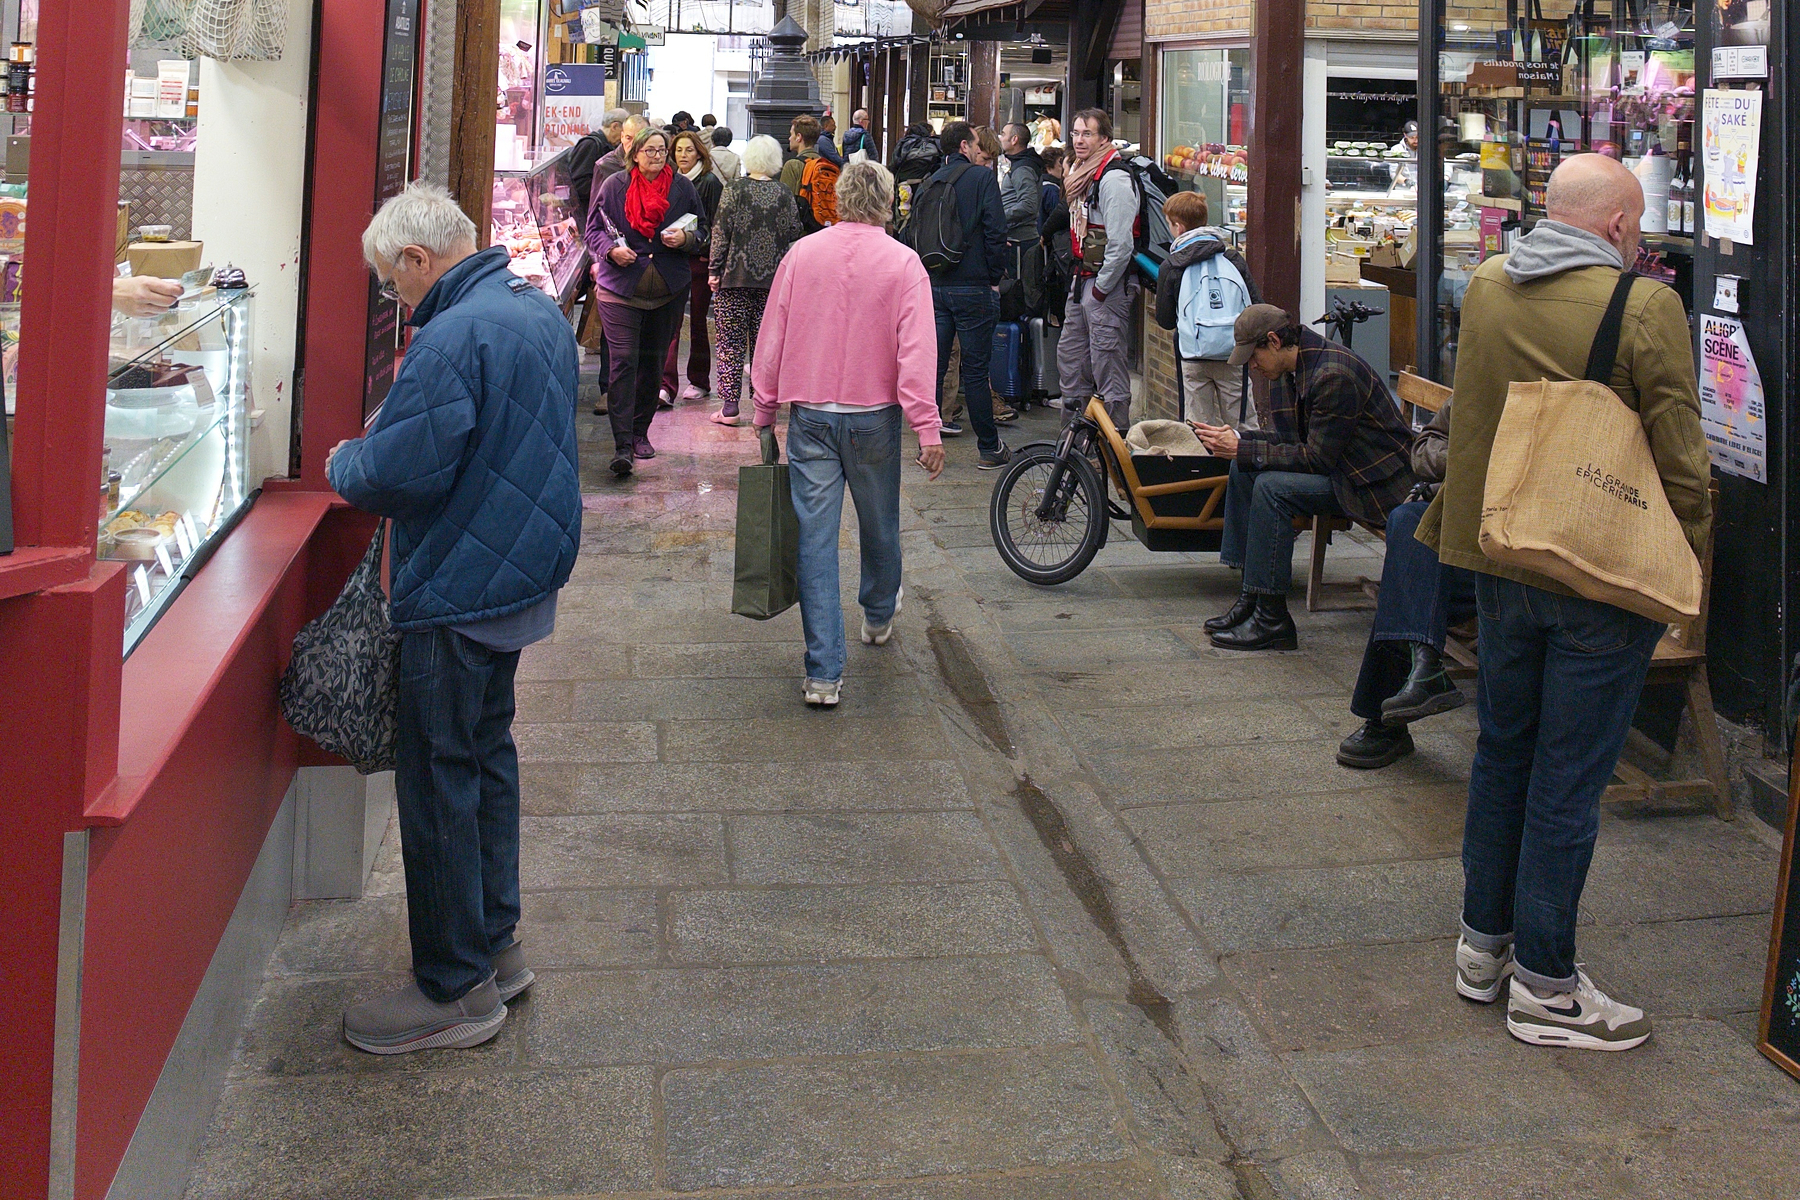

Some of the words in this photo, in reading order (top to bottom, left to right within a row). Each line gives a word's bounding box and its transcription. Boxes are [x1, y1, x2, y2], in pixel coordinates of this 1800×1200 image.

[603, 47, 615, 77] QUAIS
[545, 106, 582, 118] EK-END
[1704, 94, 1720, 109] FÊTE
[1734, 98, 1751, 110] DU
[1721, 111, 1747, 127] SAKÉ
[1704, 319, 1740, 339] ALIGR
[1704, 338, 1739, 361] SCÈNE
[1576, 466, 1623, 500] EPICERIE
[1624, 493, 1648, 510] PARIS
[1588, 463, 1602, 478] LA
[1605, 474, 1639, 498] GRANDE
